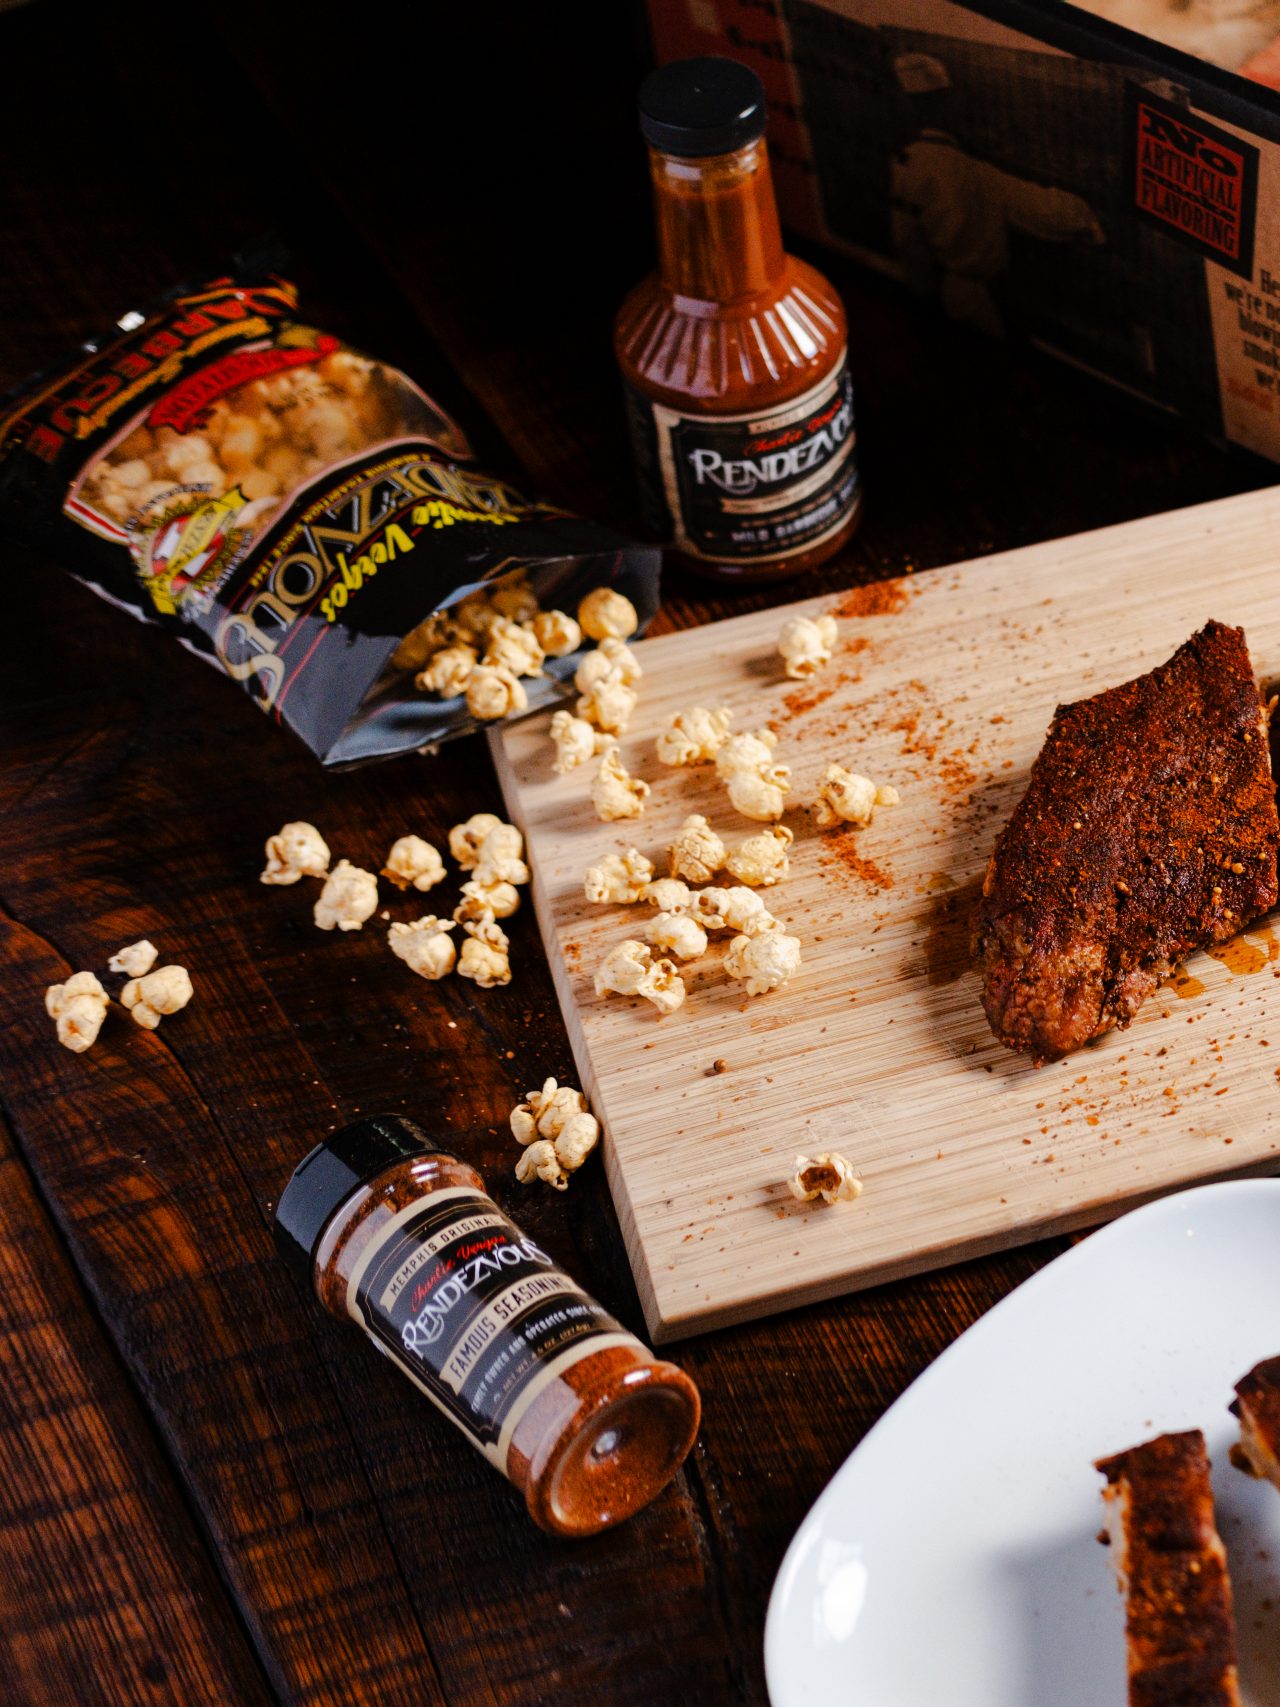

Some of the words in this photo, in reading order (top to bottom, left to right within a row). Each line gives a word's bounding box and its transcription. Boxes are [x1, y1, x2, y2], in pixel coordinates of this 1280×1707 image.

[1141, 143, 1237, 213] ARTIFICIAL
[1141, 181, 1236, 252] FLAVORING
[687, 385, 855, 496] RENDEZVO
[220, 461, 520, 713] NDEZVOUS
[319, 522, 416, 622] Vergos
[389, 1241, 438, 1297] MEMPHIS
[441, 1214, 498, 1243] ORIGINAL
[401, 1238, 553, 1360] RENDEZVOUS
[449, 1317, 497, 1380] FAMOUS
[493, 1275, 571, 1320] SEASONING
